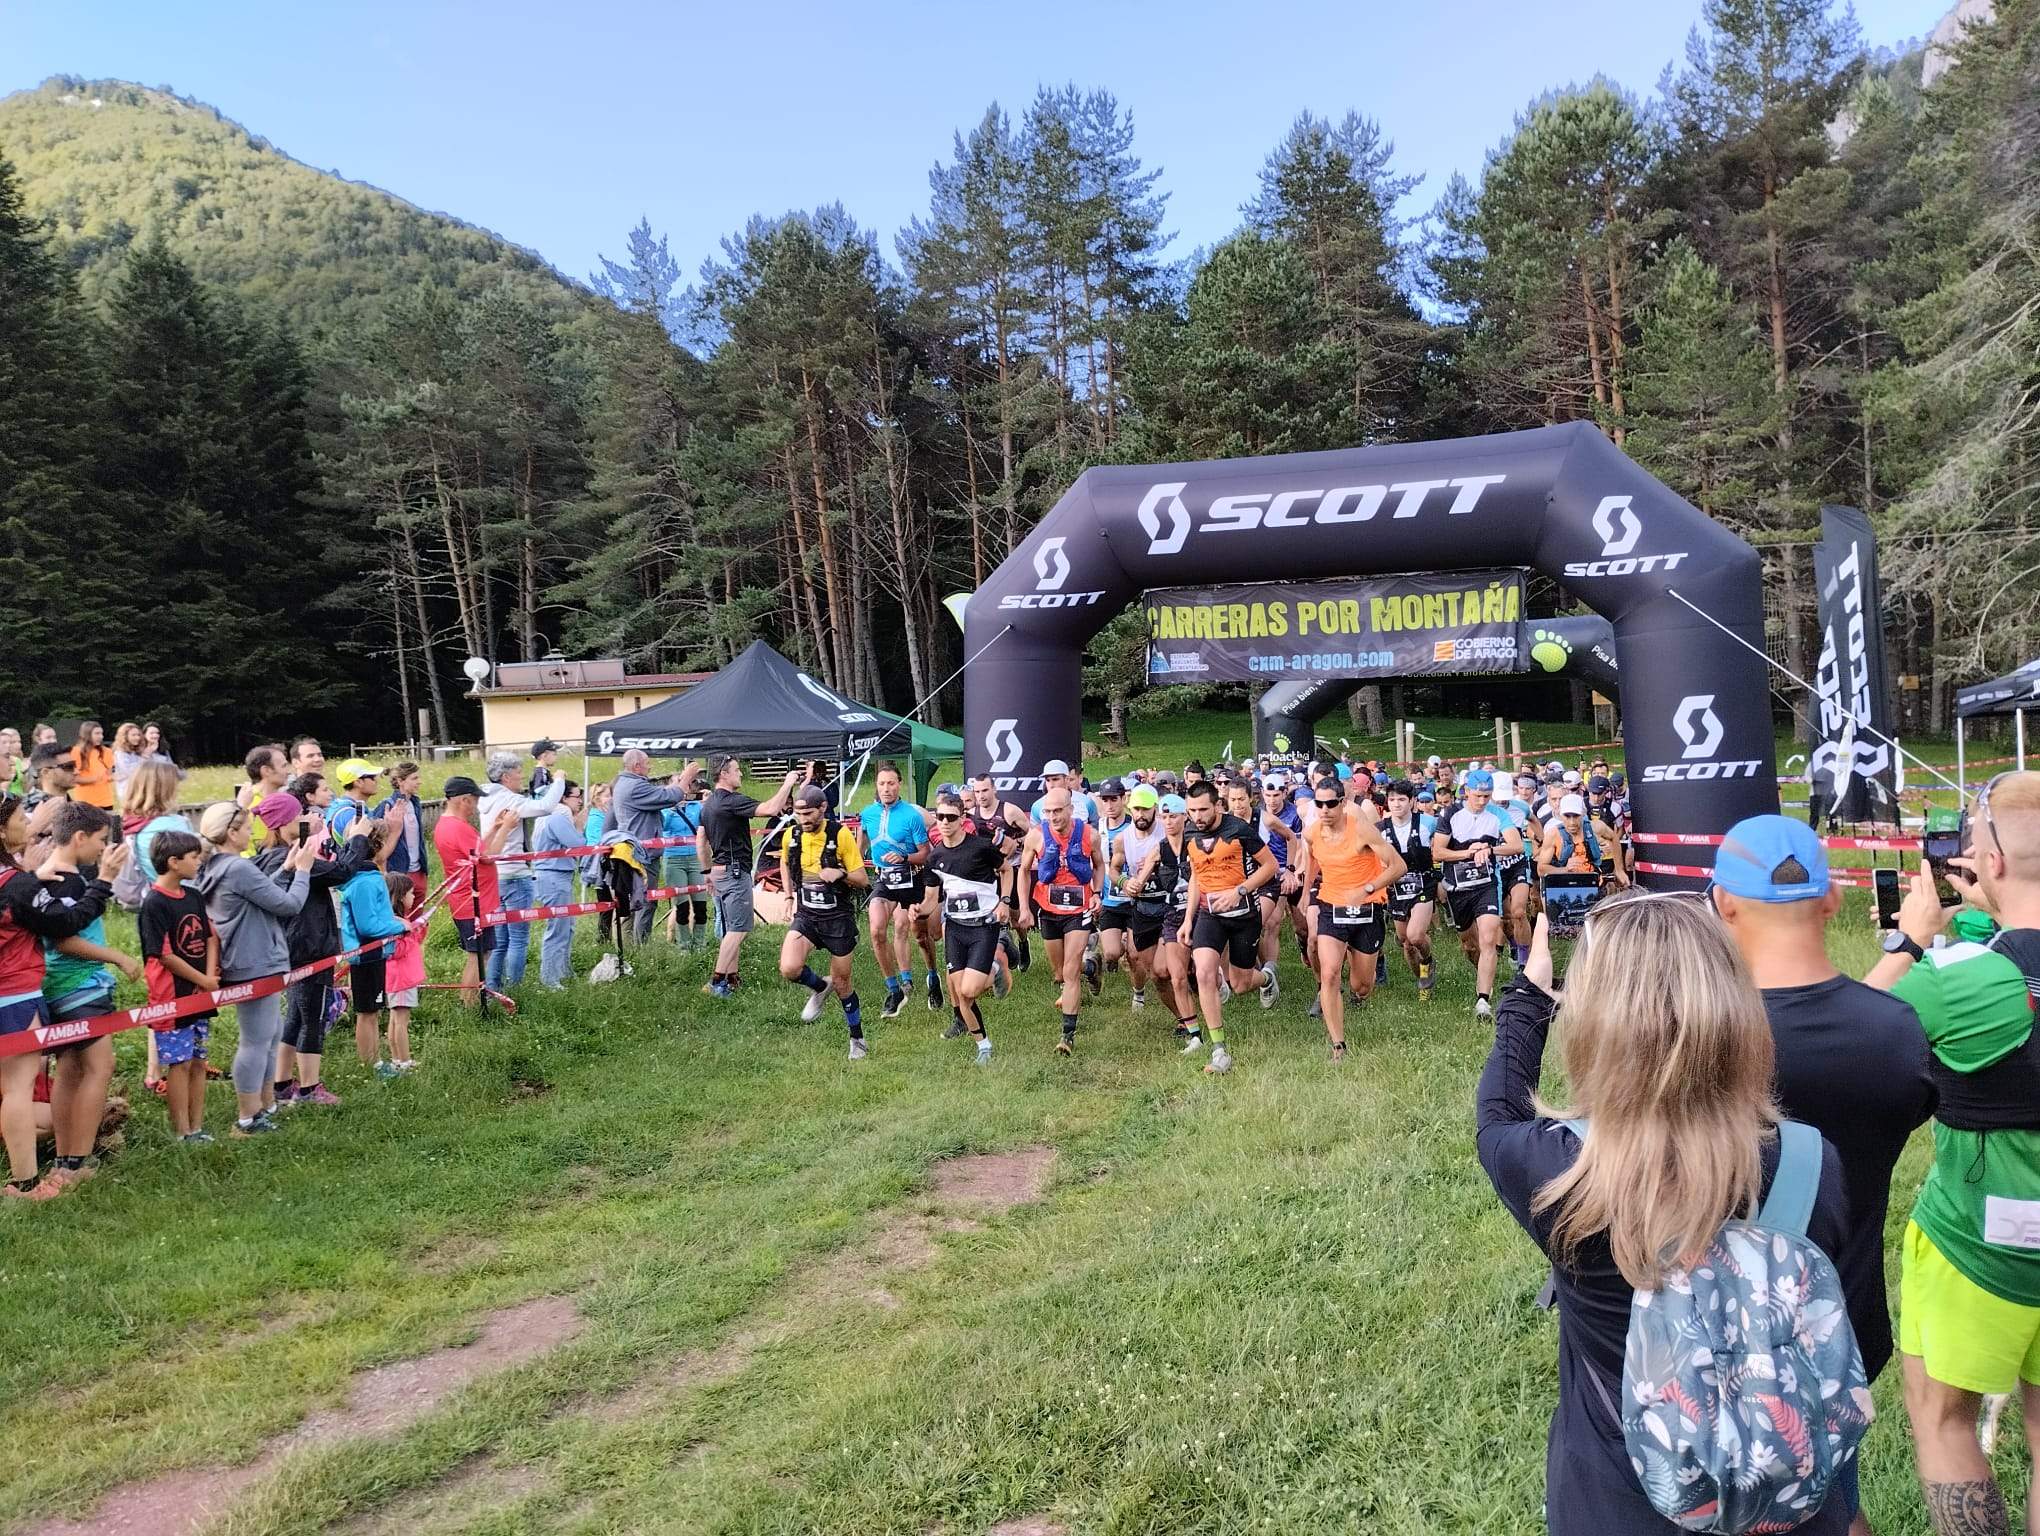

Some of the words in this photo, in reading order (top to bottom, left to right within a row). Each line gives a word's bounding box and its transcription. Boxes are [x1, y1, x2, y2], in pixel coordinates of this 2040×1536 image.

[1199, 475, 1507, 532] SCOTT
[1564, 553, 1689, 577] SCOTT
[997, 591, 1106, 609] SCOTT
[1147, 601, 1289, 639] CARRERAS
[1297, 600, 1361, 635] POR
[1371, 581, 1520, 633] MONTAÑA
[1455, 636, 1516, 649] GOBIERNO
[1248, 650, 1395, 672] cxm-aragon.com
[1455, 650, 1470, 660] DE
[1474, 647, 1518, 659] ARAGO
[1591, 645, 1610, 663] Pisa
[1282, 698, 1300, 714] Pisa
[1297, 684, 1319, 702] bien,
[616, 738, 703, 749] SCOTT
[854, 736, 880, 751] SCOTT
[1641, 760, 1762, 782] SCOTT
[889, 872, 902, 882] 95
[1465, 868, 1479, 879] 23
[1400, 882, 1416, 892] 127
[955, 899, 969, 910] 19
[1063, 892, 1070, 902] 5
[221, 984, 253, 1002] AMBAR
[140, 1002, 177, 1020] AMBAR
[47, 1020, 90, 1041] AMBAR
